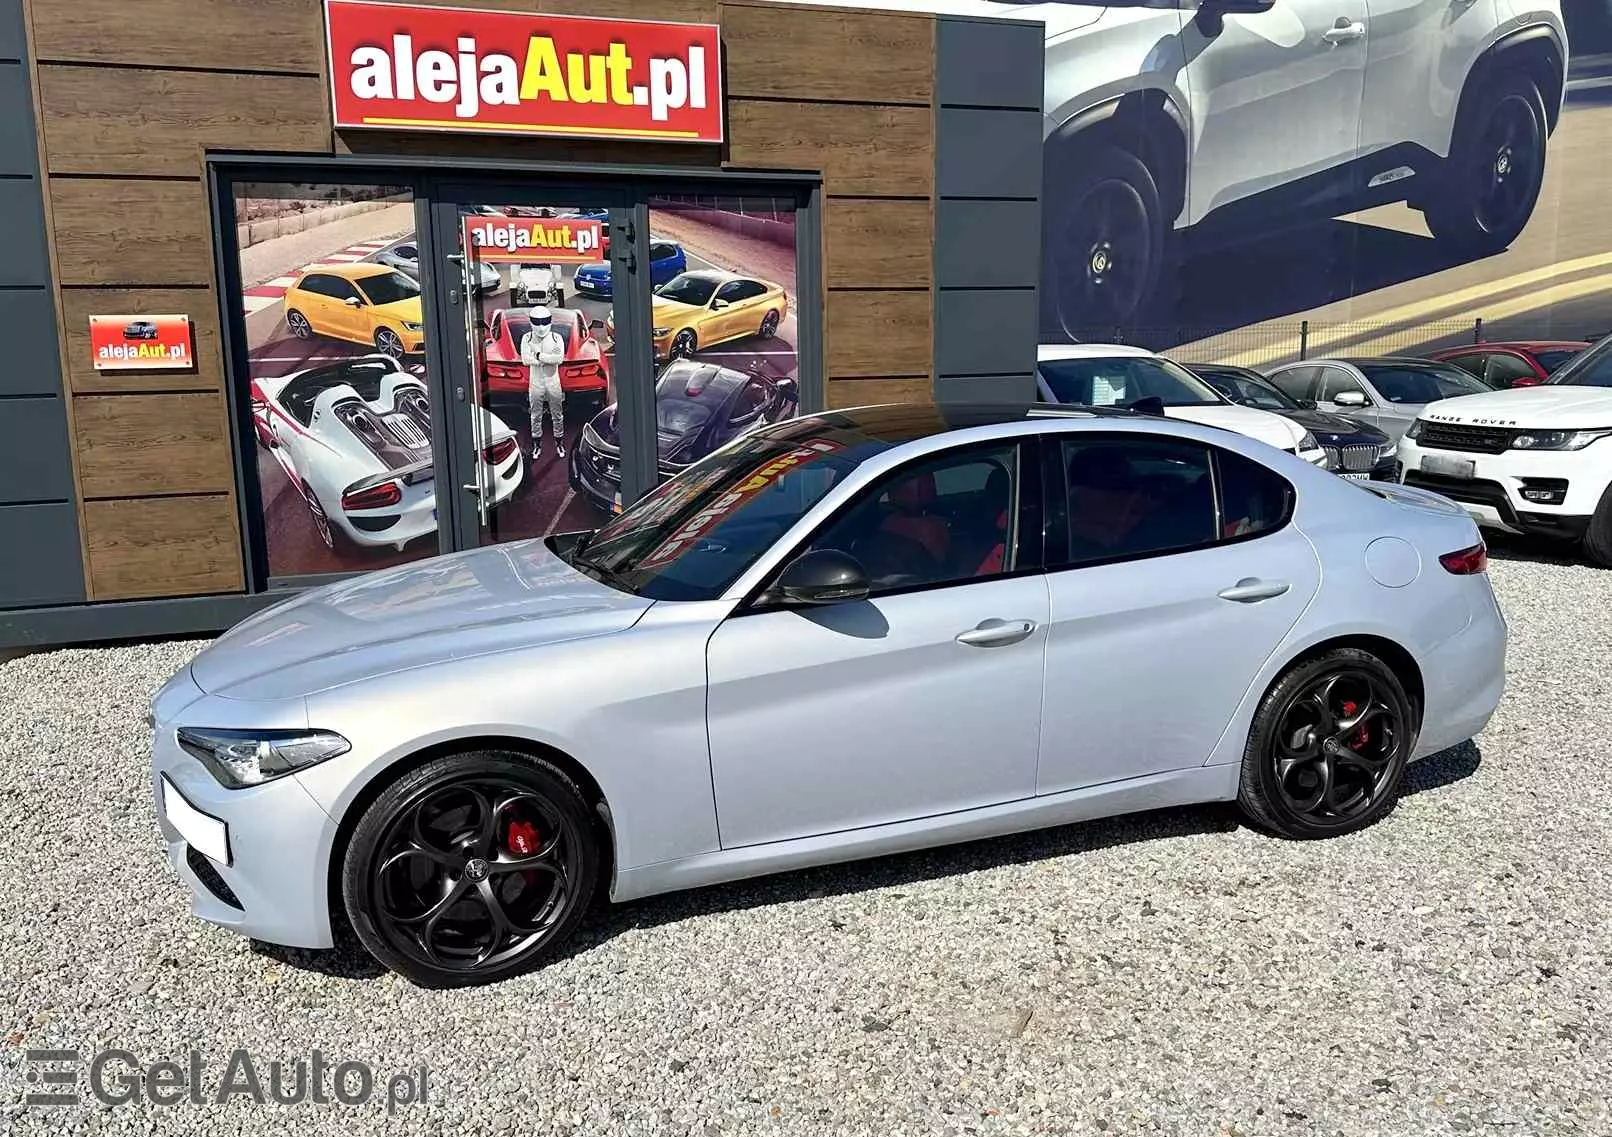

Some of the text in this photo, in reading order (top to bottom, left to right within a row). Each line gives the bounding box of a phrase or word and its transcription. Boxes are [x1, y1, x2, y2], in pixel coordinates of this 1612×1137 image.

[350, 34, 706, 120] alejaAut.pl
[471, 223, 599, 254] alejaAut.pl
[98, 343, 186, 361] alejaAut.pl
